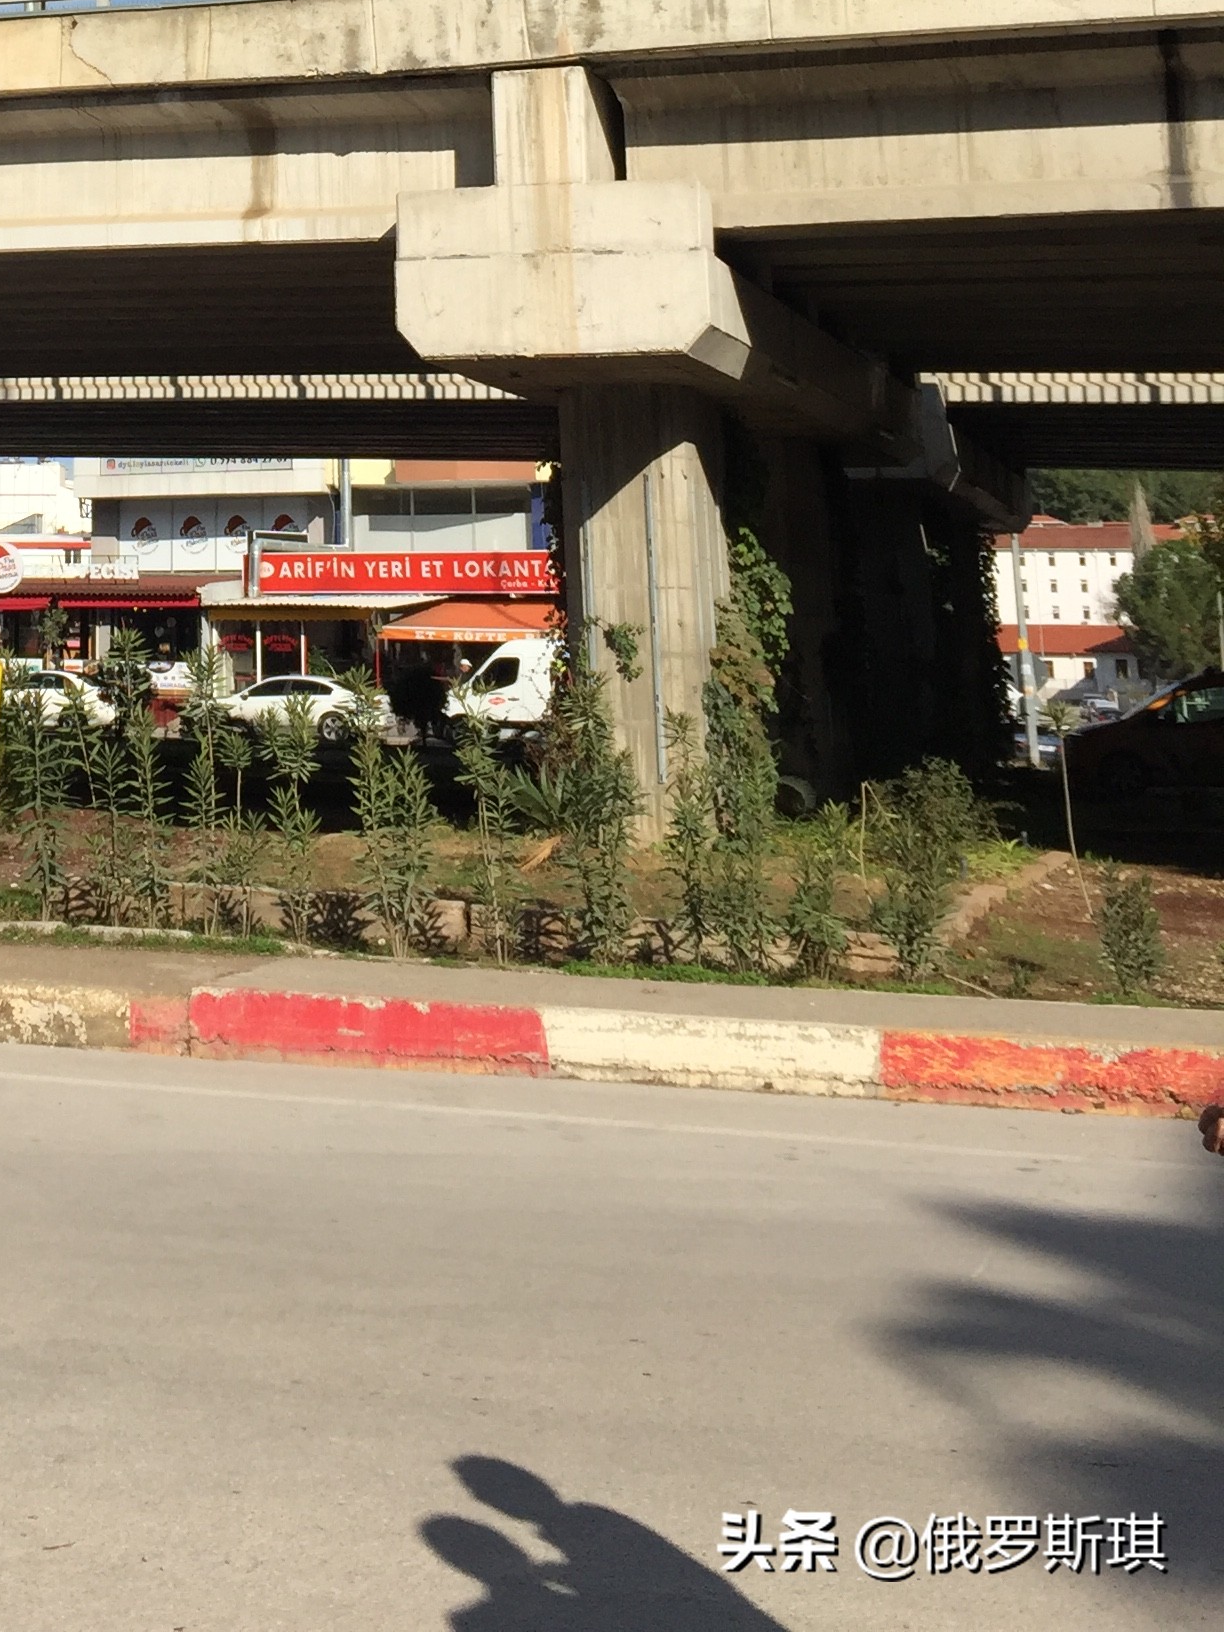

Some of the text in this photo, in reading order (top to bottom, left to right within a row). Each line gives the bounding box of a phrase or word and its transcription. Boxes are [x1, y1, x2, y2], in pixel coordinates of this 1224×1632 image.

[279, 556, 356, 578] ARİF'İN
[364, 556, 411, 578] YERİ
[420, 560, 443, 578] ET
[414, 630, 507, 641] ET KÖFTE
